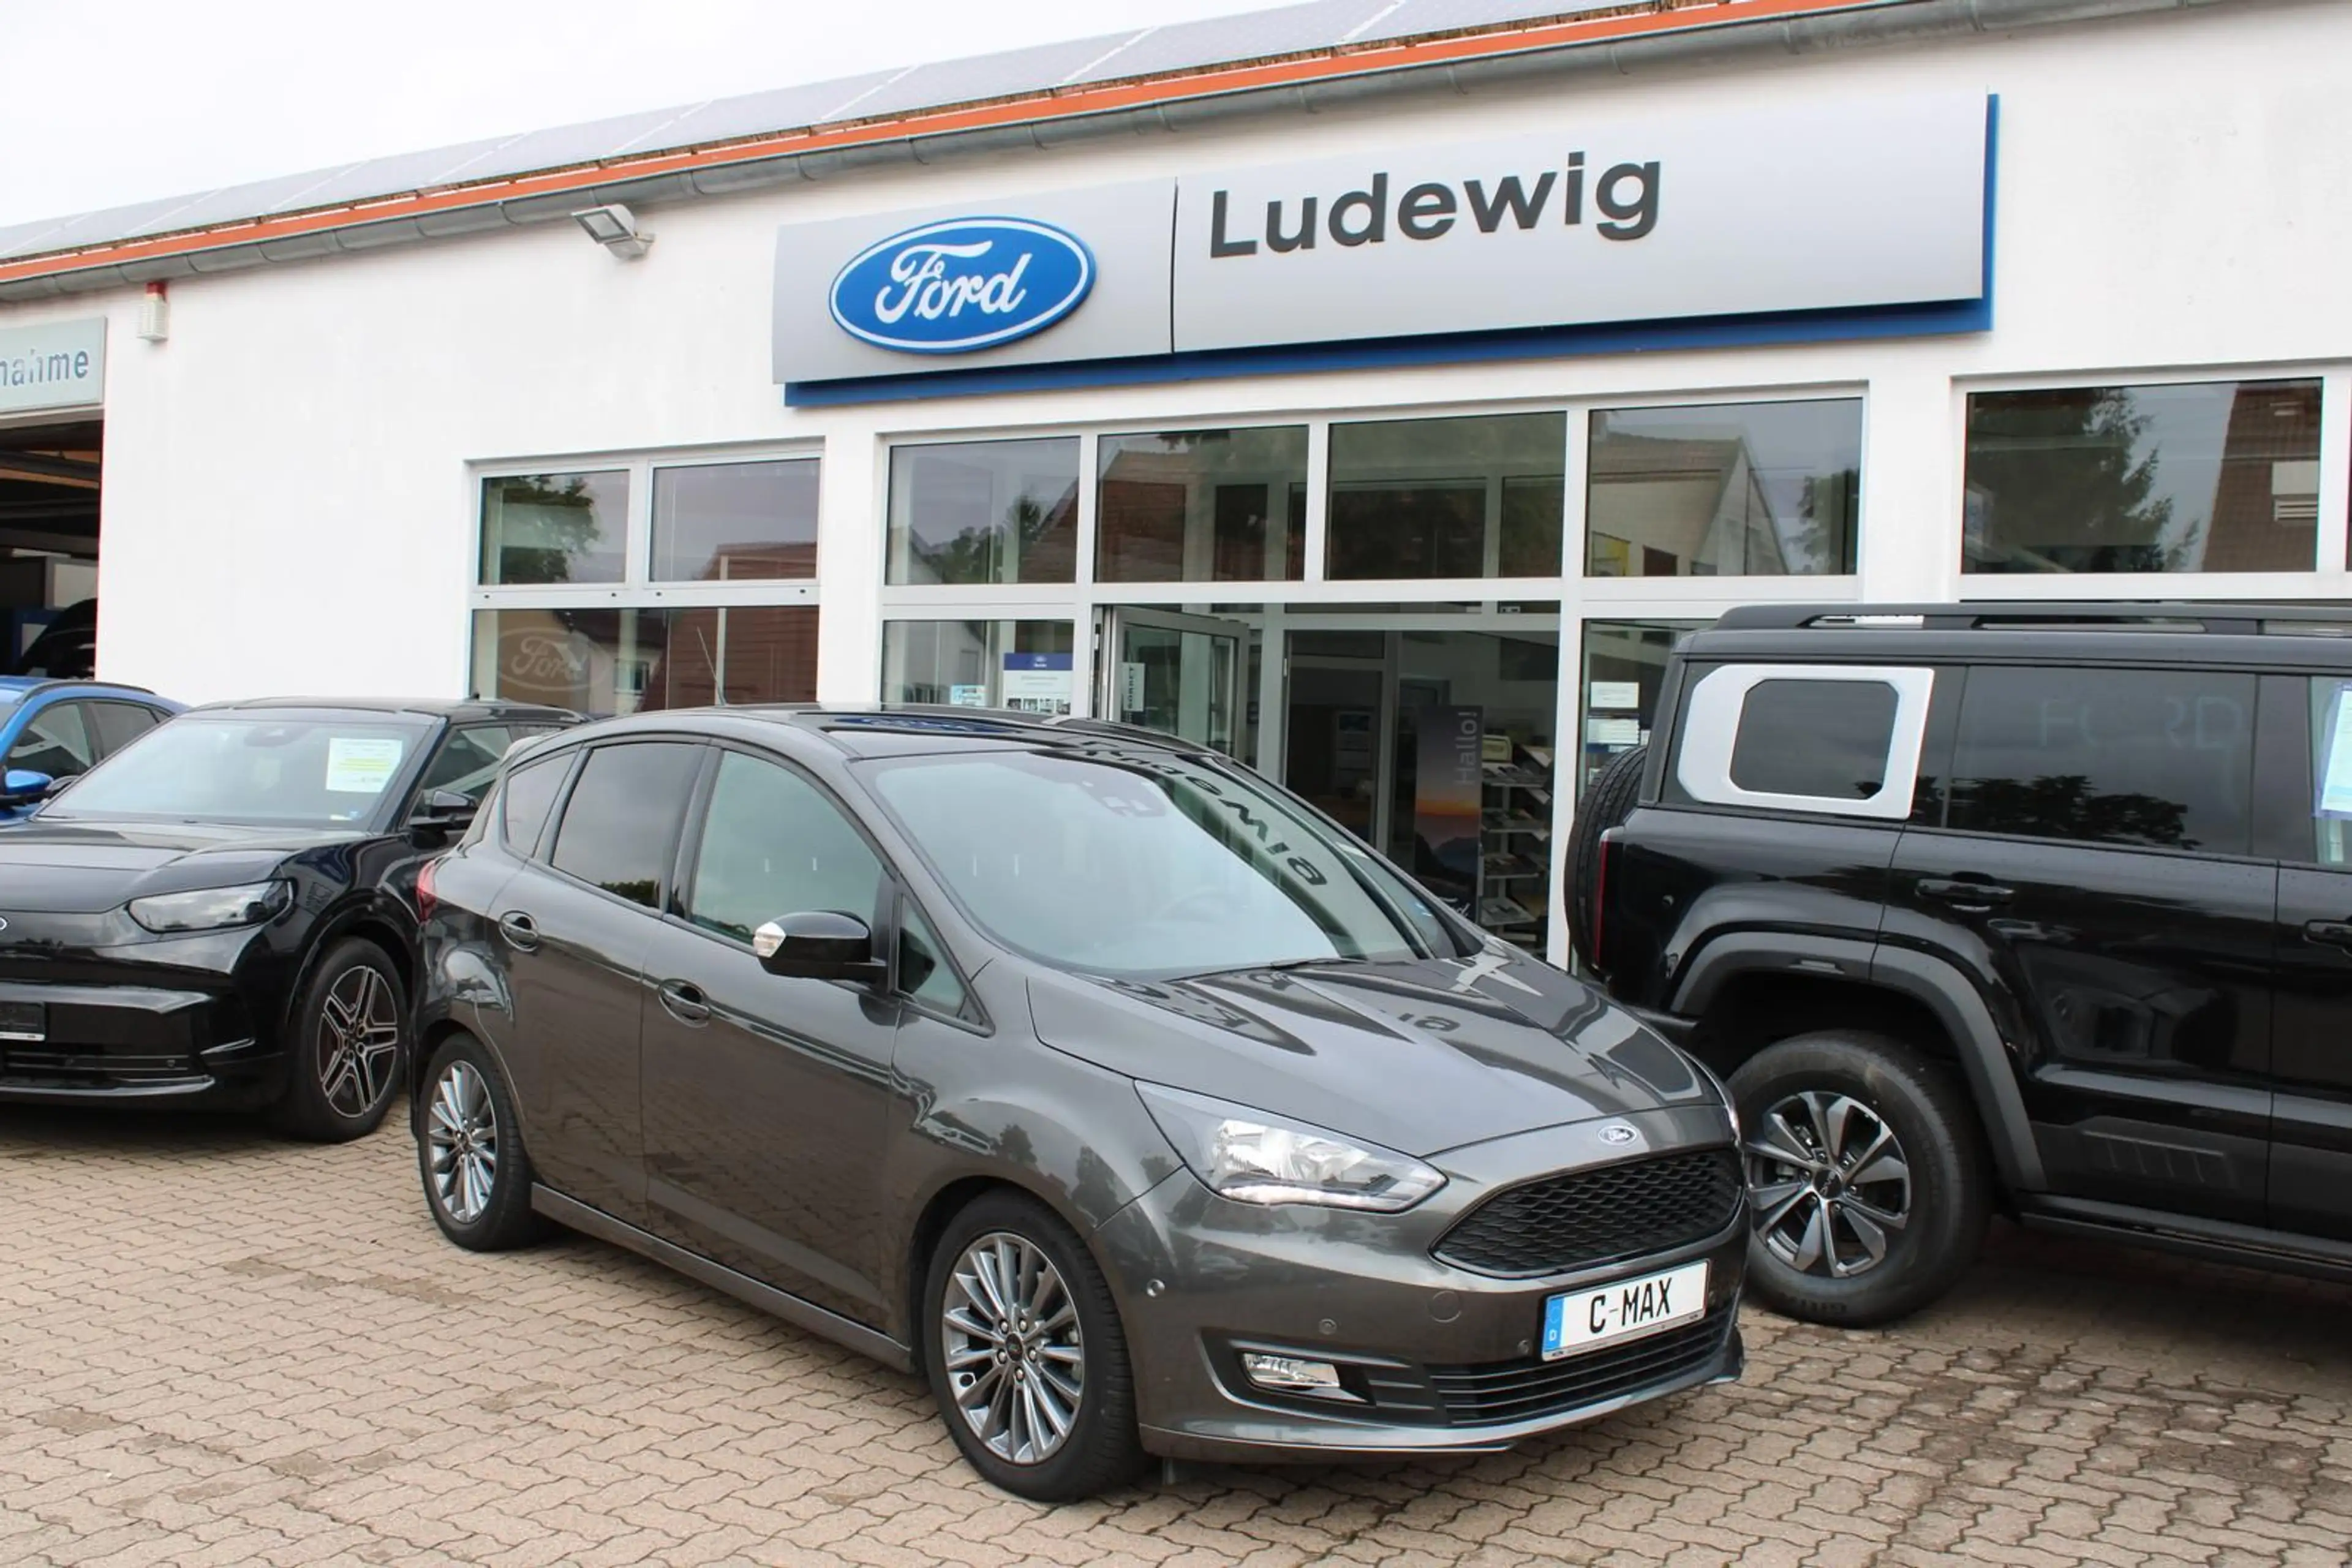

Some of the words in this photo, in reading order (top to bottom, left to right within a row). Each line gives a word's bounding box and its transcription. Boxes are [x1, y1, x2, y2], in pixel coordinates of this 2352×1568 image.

[1210, 151, 1660, 258] Ludewig
[875, 240, 1033, 323] Ford
[1455, 711, 1477, 785] Hallo!
[1589, 1276, 1672, 1334] C-MAX
